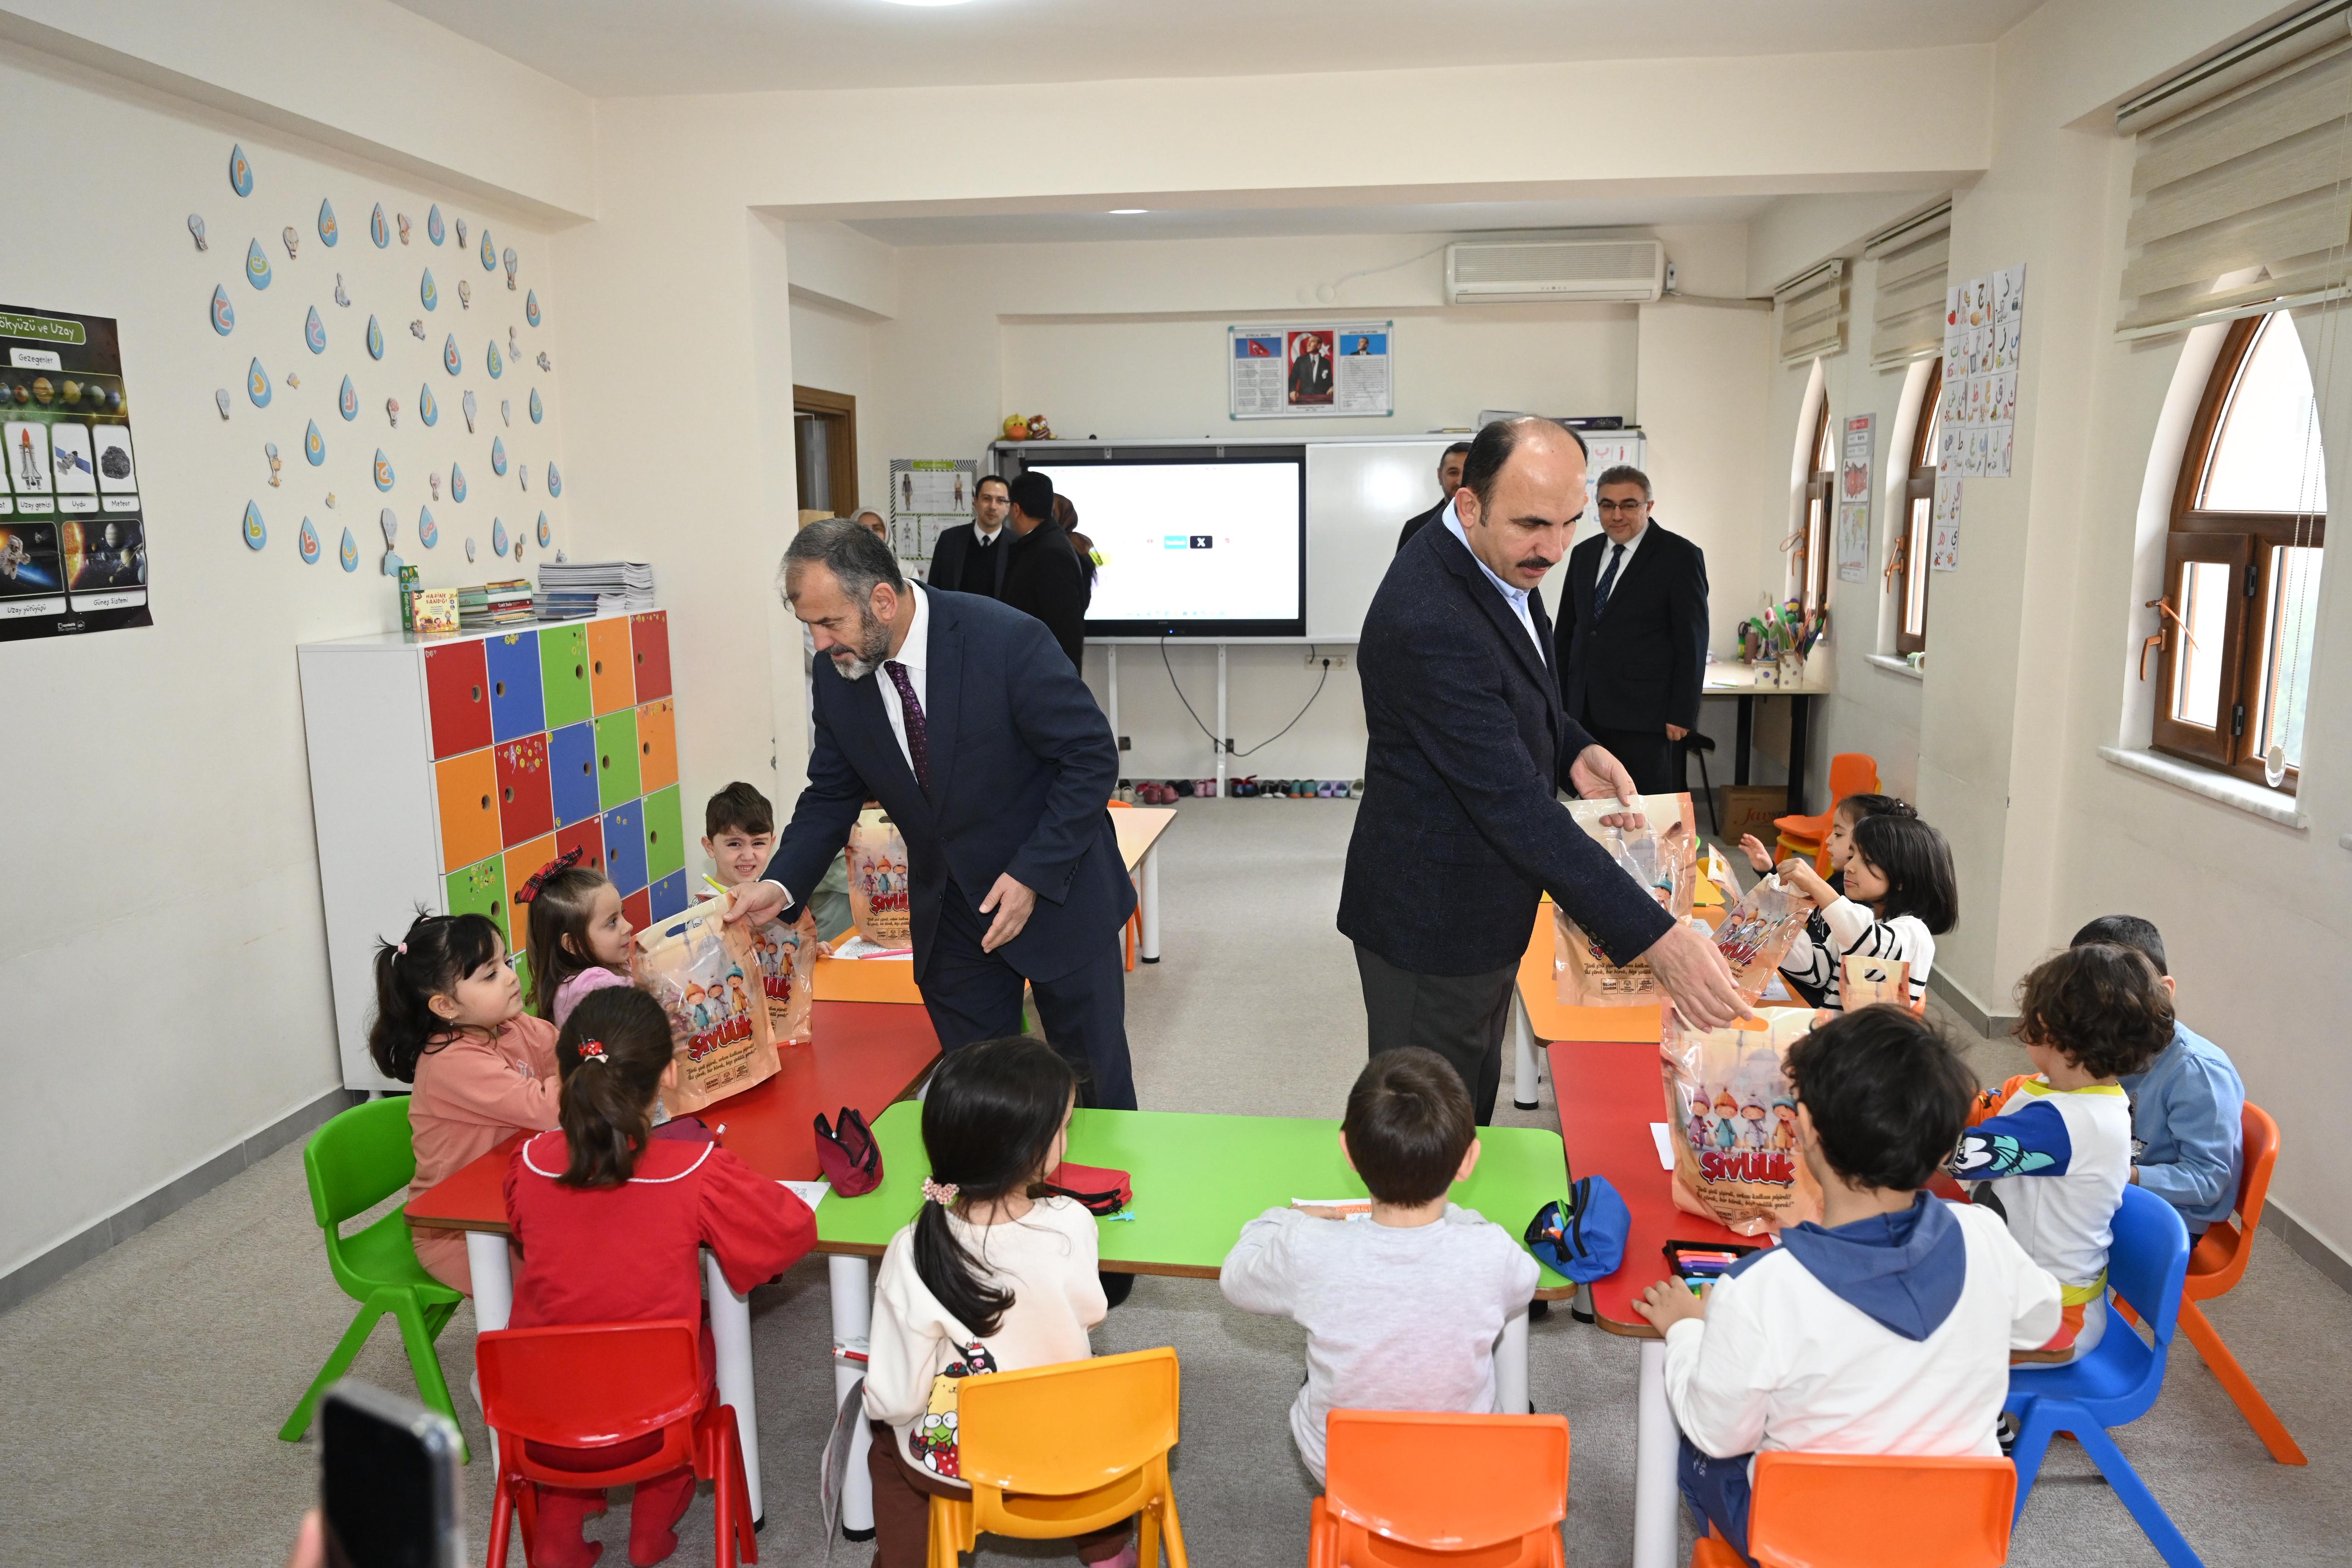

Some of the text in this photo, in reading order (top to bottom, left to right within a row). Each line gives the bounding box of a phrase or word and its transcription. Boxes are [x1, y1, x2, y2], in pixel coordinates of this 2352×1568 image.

[237, 159, 246, 186] م
[321, 216, 335, 235] ش
[249, 257, 268, 274] ت
[1978, 283, 1984, 310] ج
[215, 299, 231, 328] ح
[38, 325, 48, 334] ve
[51, 322, 74, 341] Uzay
[309, 317, 323, 345] خ
[18, 354, 53, 366] Gezegenler
[1951, 345, 1958, 358] ت
[345, 389, 353, 411] ك
[1996, 378, 2003, 404] ق
[1957, 430, 1963, 451] ط
[377, 462, 391, 484] ج
[20, 501, 51, 511] Uzay gemisi
[72, 501, 86, 510] Uydu
[248, 516, 262, 537] ط
[302, 530, 317, 554] ظ
[1197, 537, 1206, 547] X
[343, 545, 355, 564] ب
[7, 603, 47, 615] Uzay yürüyüşü
[94, 598, 110, 607] Güneş
[687, 1013, 754, 1062] Şivlilik
[729, 1049, 743, 1059] kalkan
[1699, 1151, 1797, 1189] Şivlilik
[1774, 1201, 1795, 1210] gerek!"
